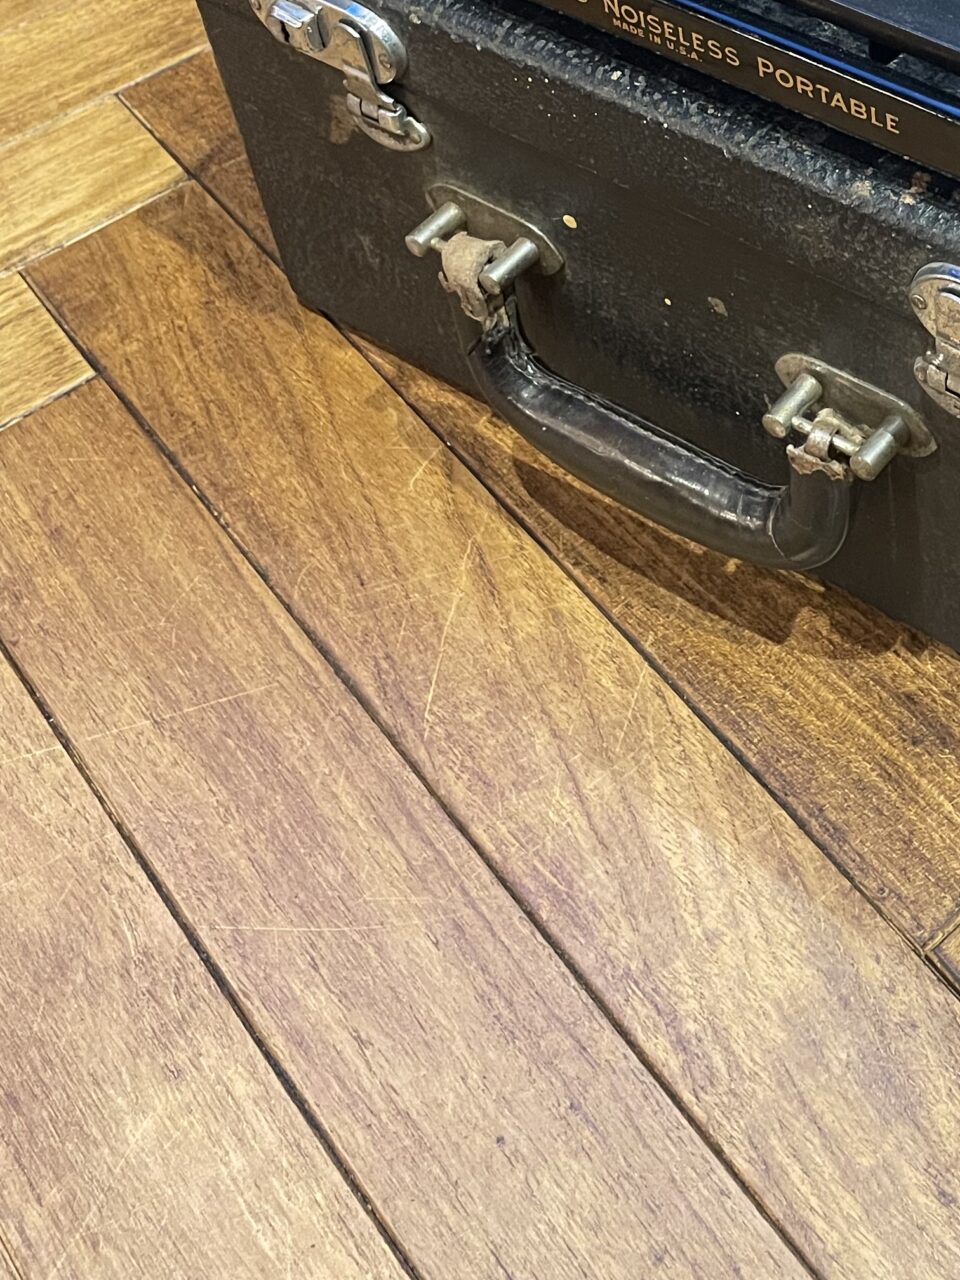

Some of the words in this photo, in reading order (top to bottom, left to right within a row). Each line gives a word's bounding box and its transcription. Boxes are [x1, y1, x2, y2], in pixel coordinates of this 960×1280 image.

[612, 18, 645, 38] MADE
[649, 33, 662, 45] IN
[758, 56, 900, 135] PORTABLE
